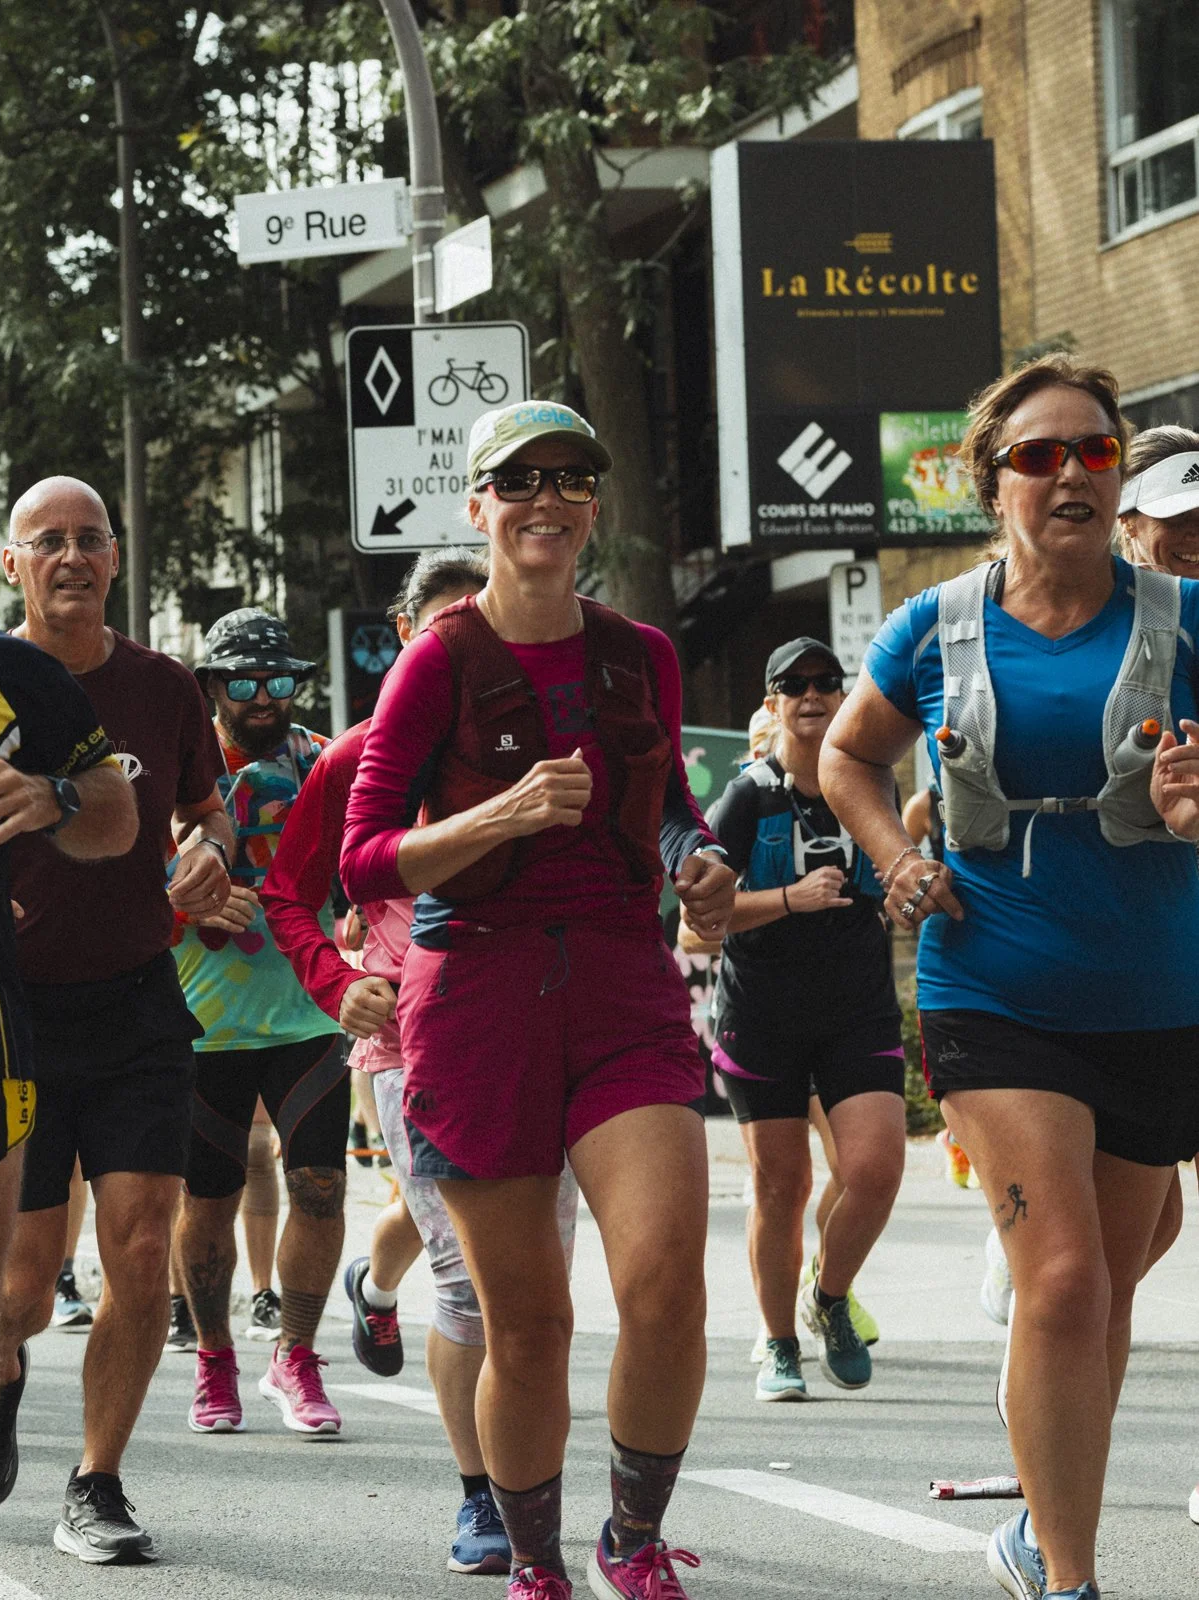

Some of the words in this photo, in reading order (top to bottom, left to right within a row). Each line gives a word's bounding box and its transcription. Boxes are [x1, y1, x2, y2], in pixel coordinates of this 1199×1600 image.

[266, 215, 294, 245] 9e
[305, 210, 366, 241] Rue
[761, 267, 808, 297] La
[824, 263, 979, 296] Récolte
[431, 427, 463, 446] MAI
[429, 451, 453, 470] AU
[385, 478, 403, 497] 31
[757, 503, 807, 519] COURS
[808, 503, 828, 518] DE
[829, 502, 875, 517] PIANO
[846, 566, 867, 605] P
